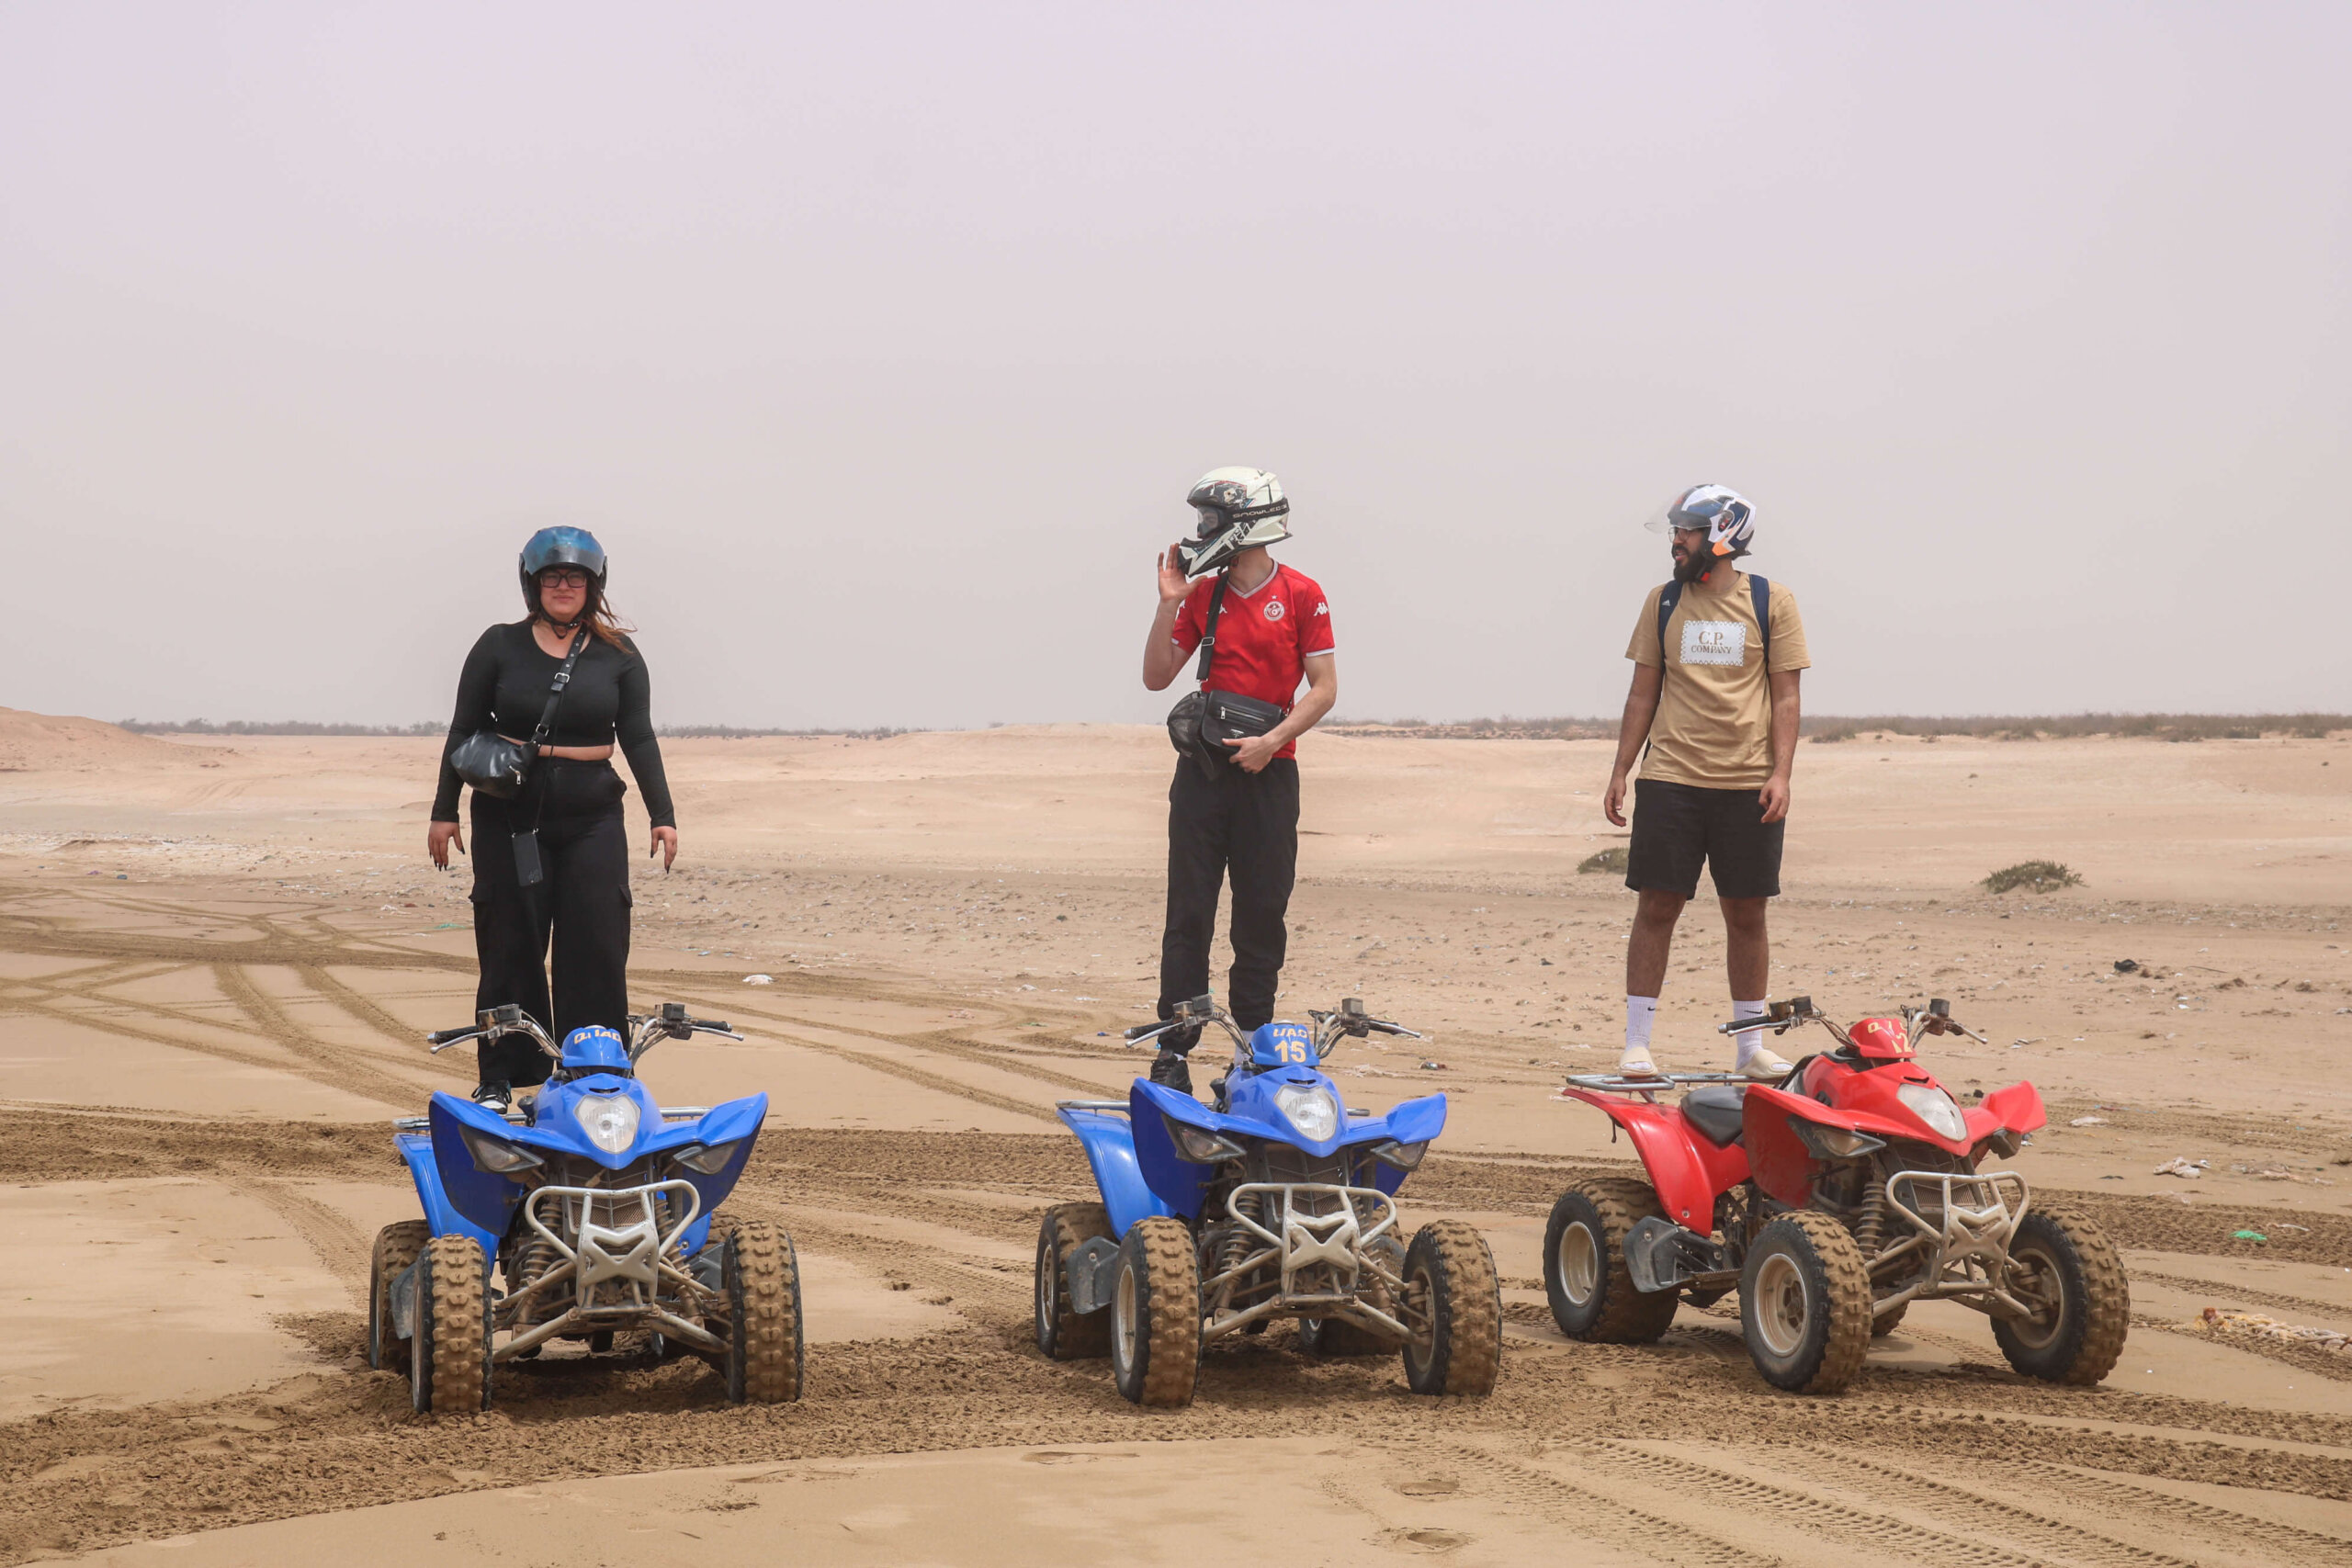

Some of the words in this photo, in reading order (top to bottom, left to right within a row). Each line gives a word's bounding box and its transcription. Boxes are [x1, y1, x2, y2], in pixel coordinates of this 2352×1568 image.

[1698, 630, 1724, 646] C.P.
[1690, 645, 1733, 654] COMPANY
[1274, 1040, 1306, 1063] 15
